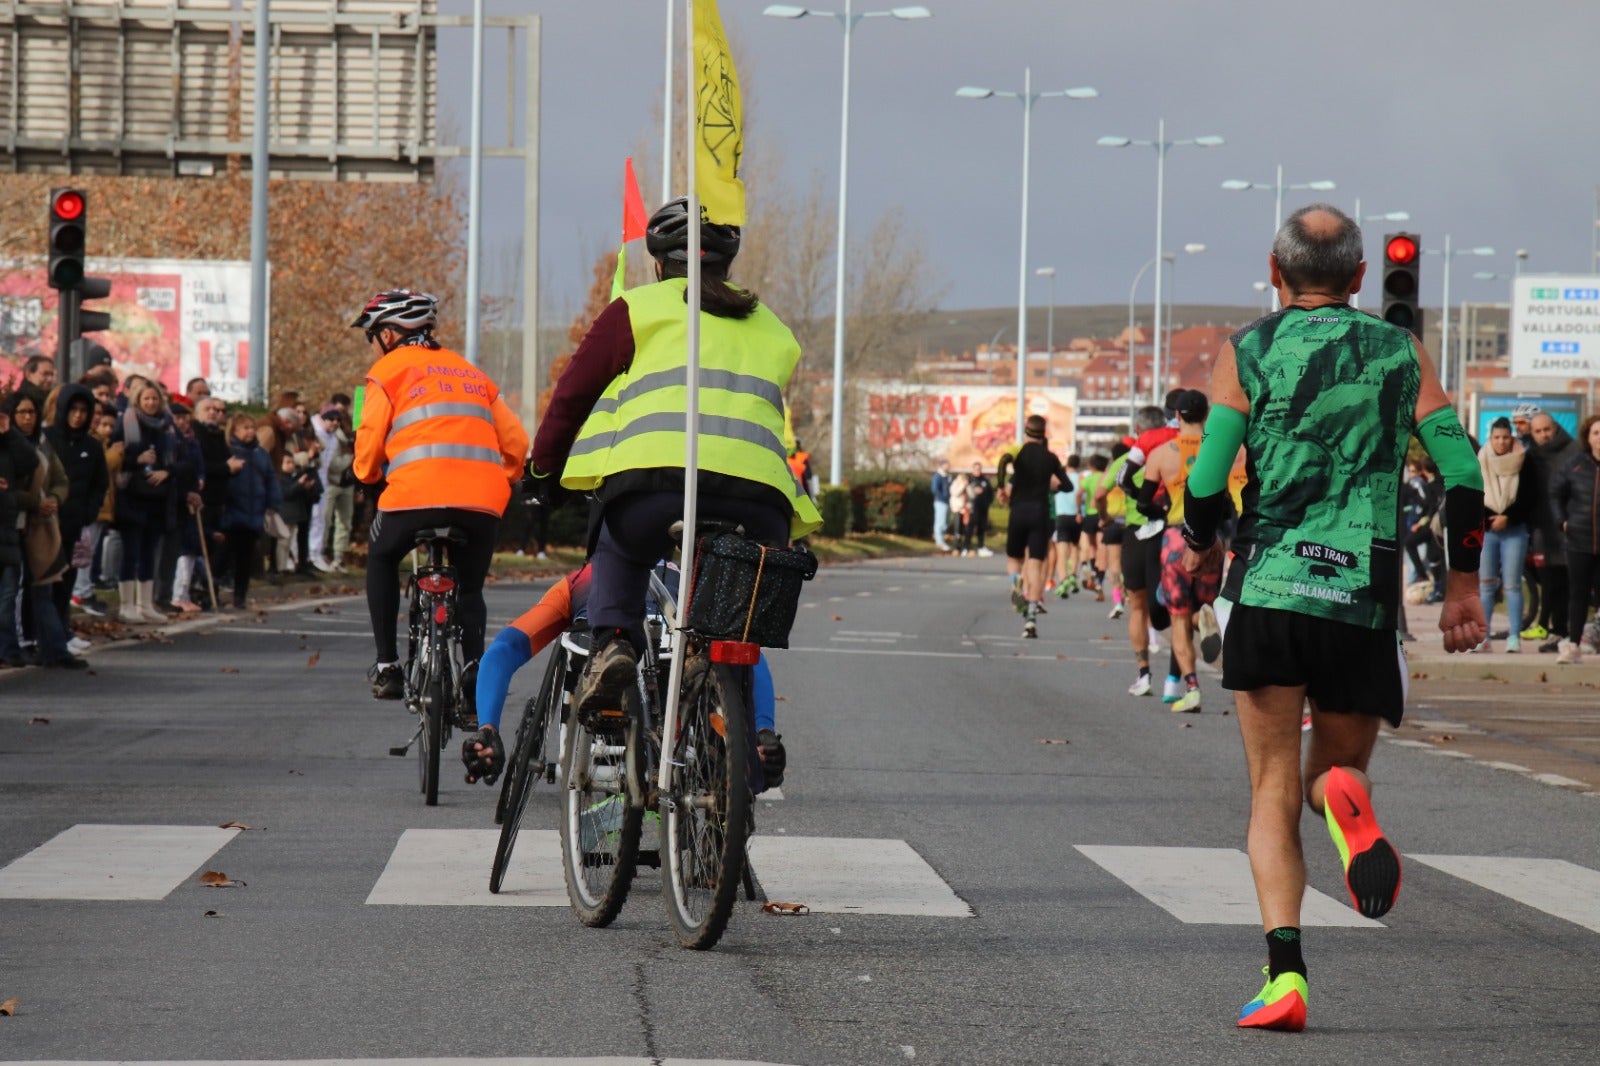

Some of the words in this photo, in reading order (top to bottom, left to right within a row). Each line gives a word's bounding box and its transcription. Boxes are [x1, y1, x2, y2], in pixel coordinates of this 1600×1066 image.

[1528, 305, 1600, 316] PORTUGAL
[1523, 323, 1600, 333] VALLADOLI
[1532, 358, 1591, 369] ZAMORA
[427, 365, 486, 381] AMIGOS
[211, 382, 241, 393] KFC
[438, 380, 453, 393] la
[1302, 545, 1322, 558] AVS
[1324, 547, 1349, 566] TRAIL
[1292, 582, 1352, 604] SALAMANCA
